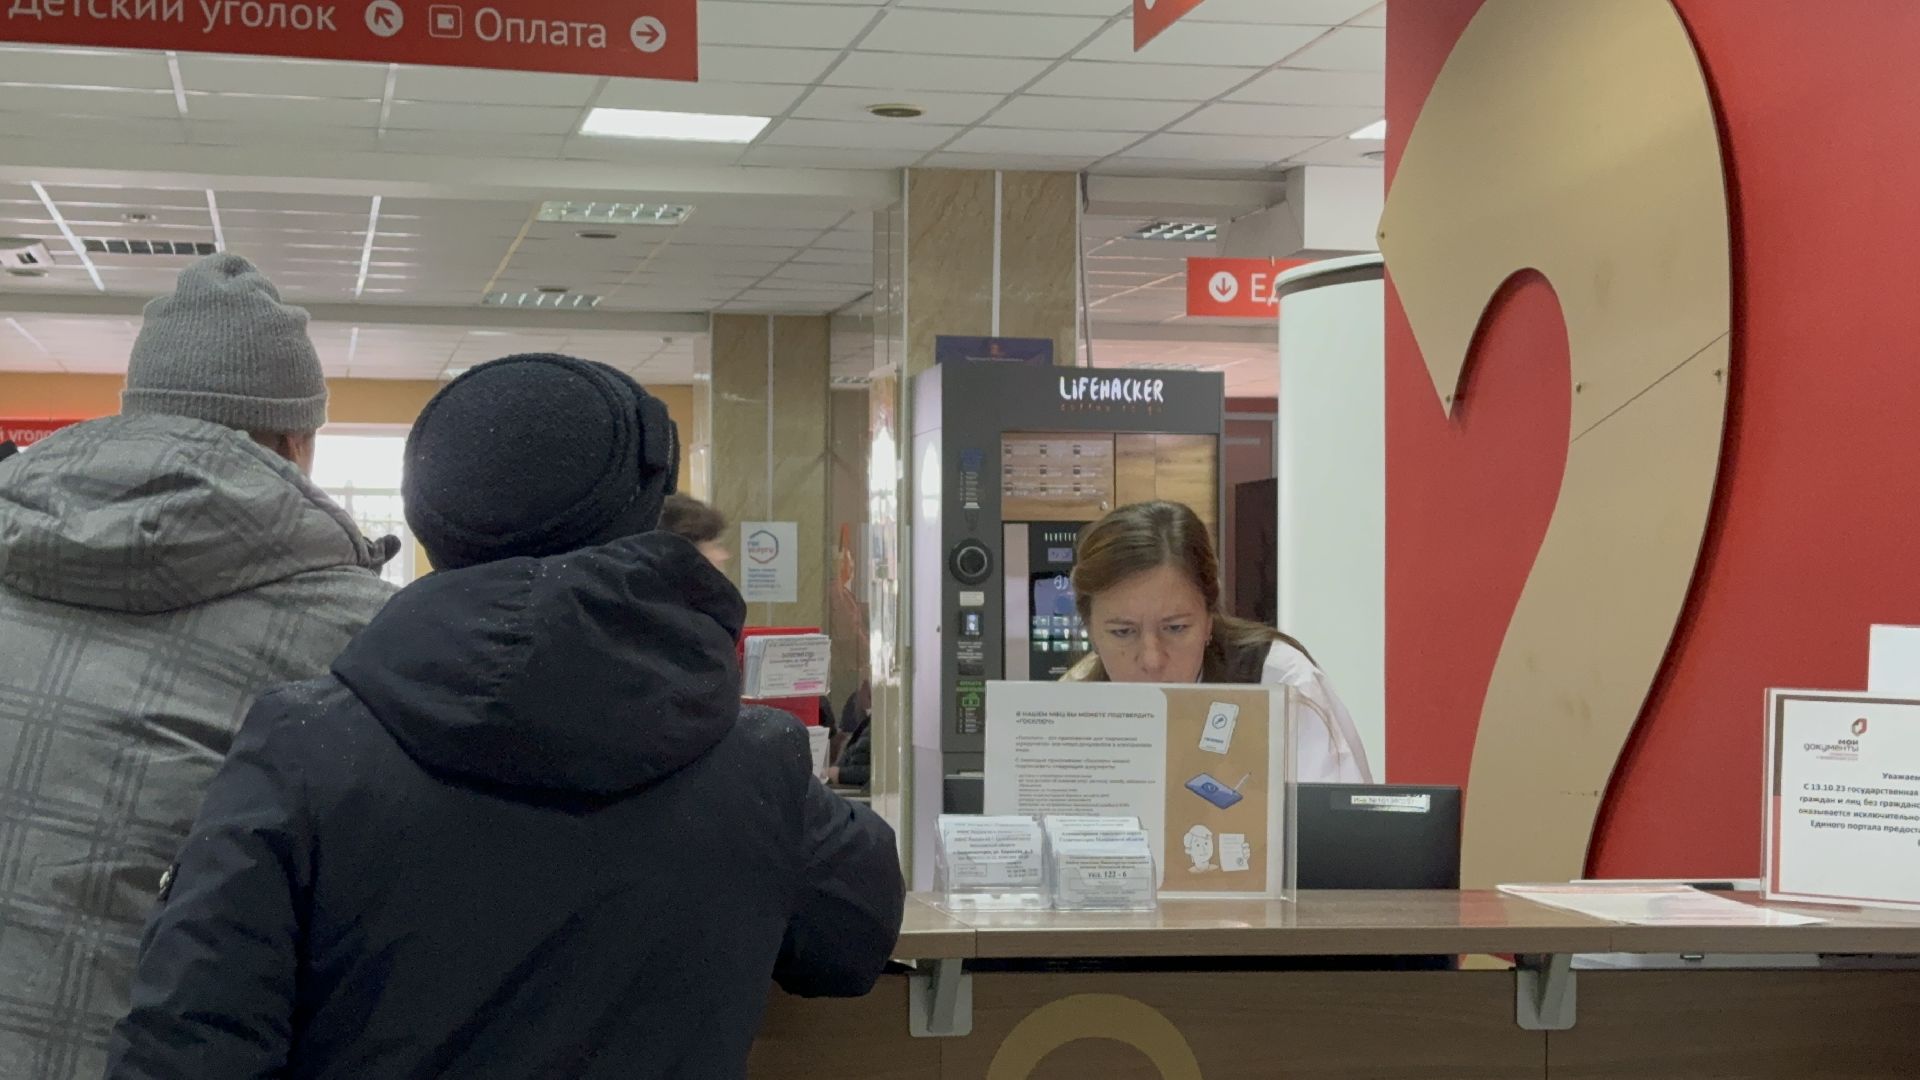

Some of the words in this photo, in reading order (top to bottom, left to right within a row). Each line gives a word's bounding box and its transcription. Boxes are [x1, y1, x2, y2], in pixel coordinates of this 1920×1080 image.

[202, 0, 337, 33] уголок
[474, 7, 607, 49] Оплата
[1811, 783, 1846, 792] 13.10.23
[1847, 787, 1919, 796] государственная
[1799, 796, 1836, 804] граждан
[1845, 798, 1861, 806] лиц
[1863, 798, 1878, 806] без
[1798, 808, 1851, 817] оказывается
[1853, 812, 1920, 821] исключительно
[1810, 820, 1846, 829] Единого
[1847, 823, 1882, 832] портала
